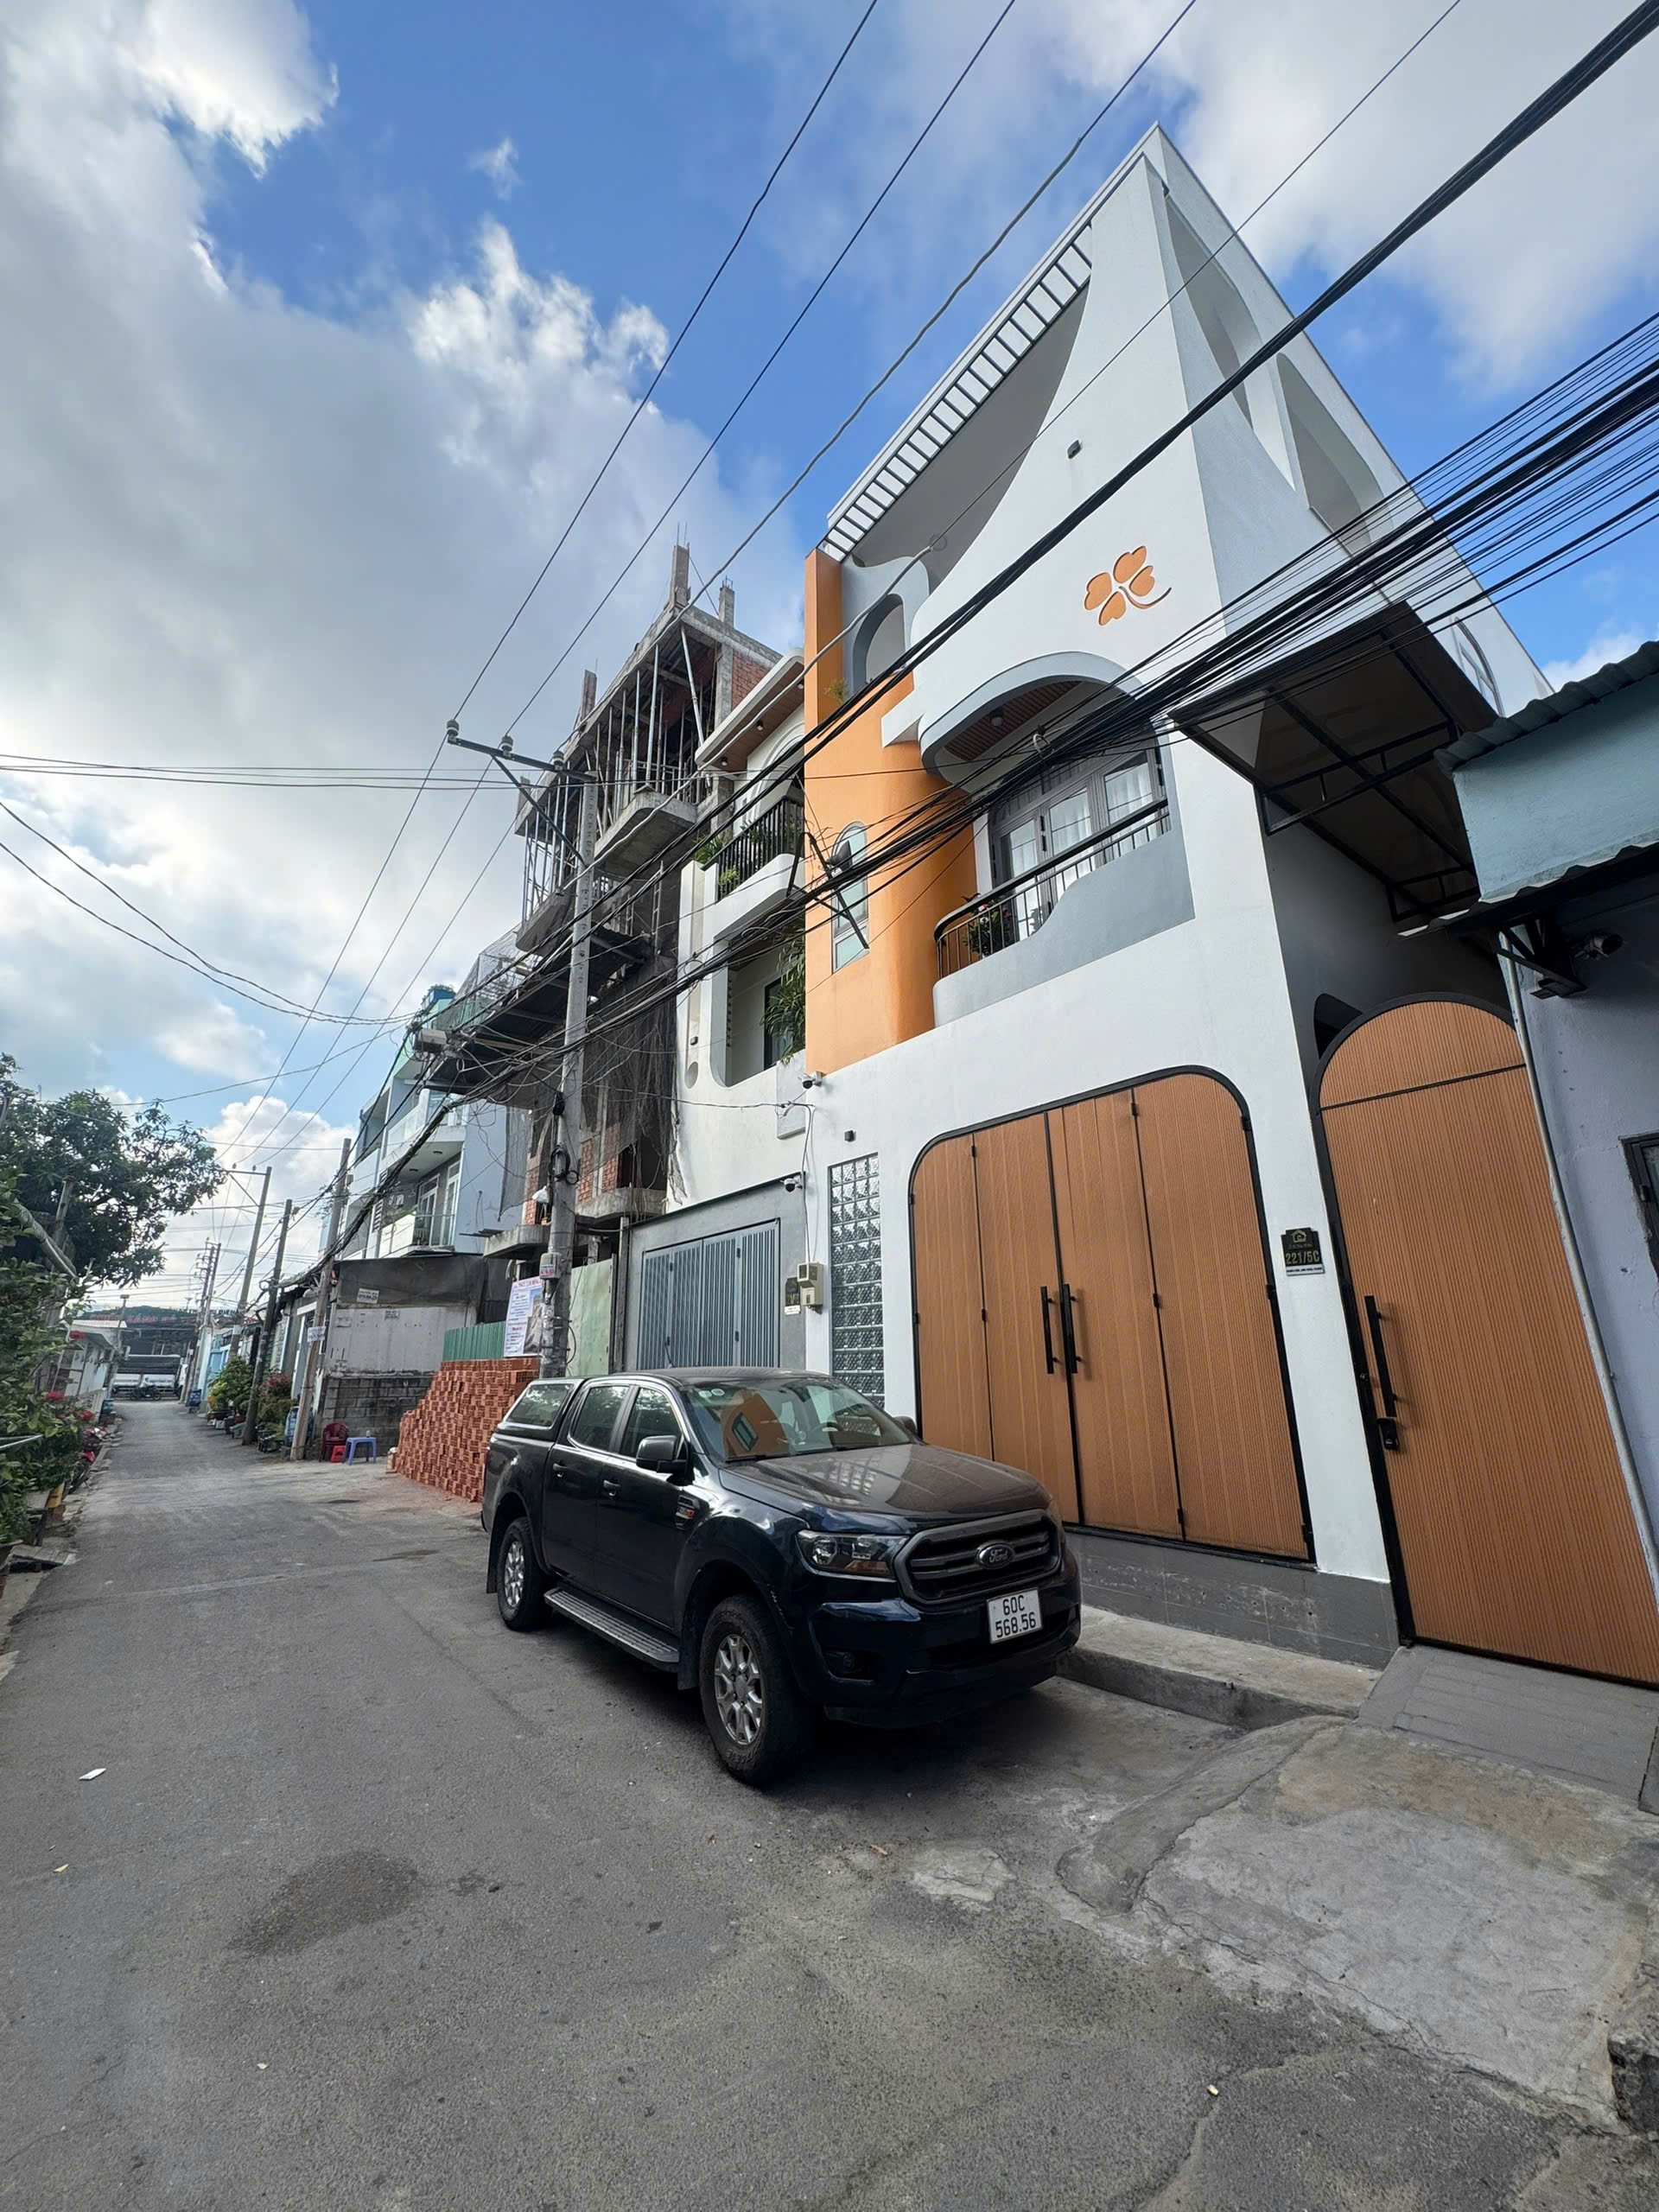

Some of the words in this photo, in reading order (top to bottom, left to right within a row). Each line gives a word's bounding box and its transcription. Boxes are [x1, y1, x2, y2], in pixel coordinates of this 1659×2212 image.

[1285, 1249, 1320, 1264] 221/5C
[1002, 1594, 1025, 1616] 60C
[995, 1611, 1036, 1637] 568.56
